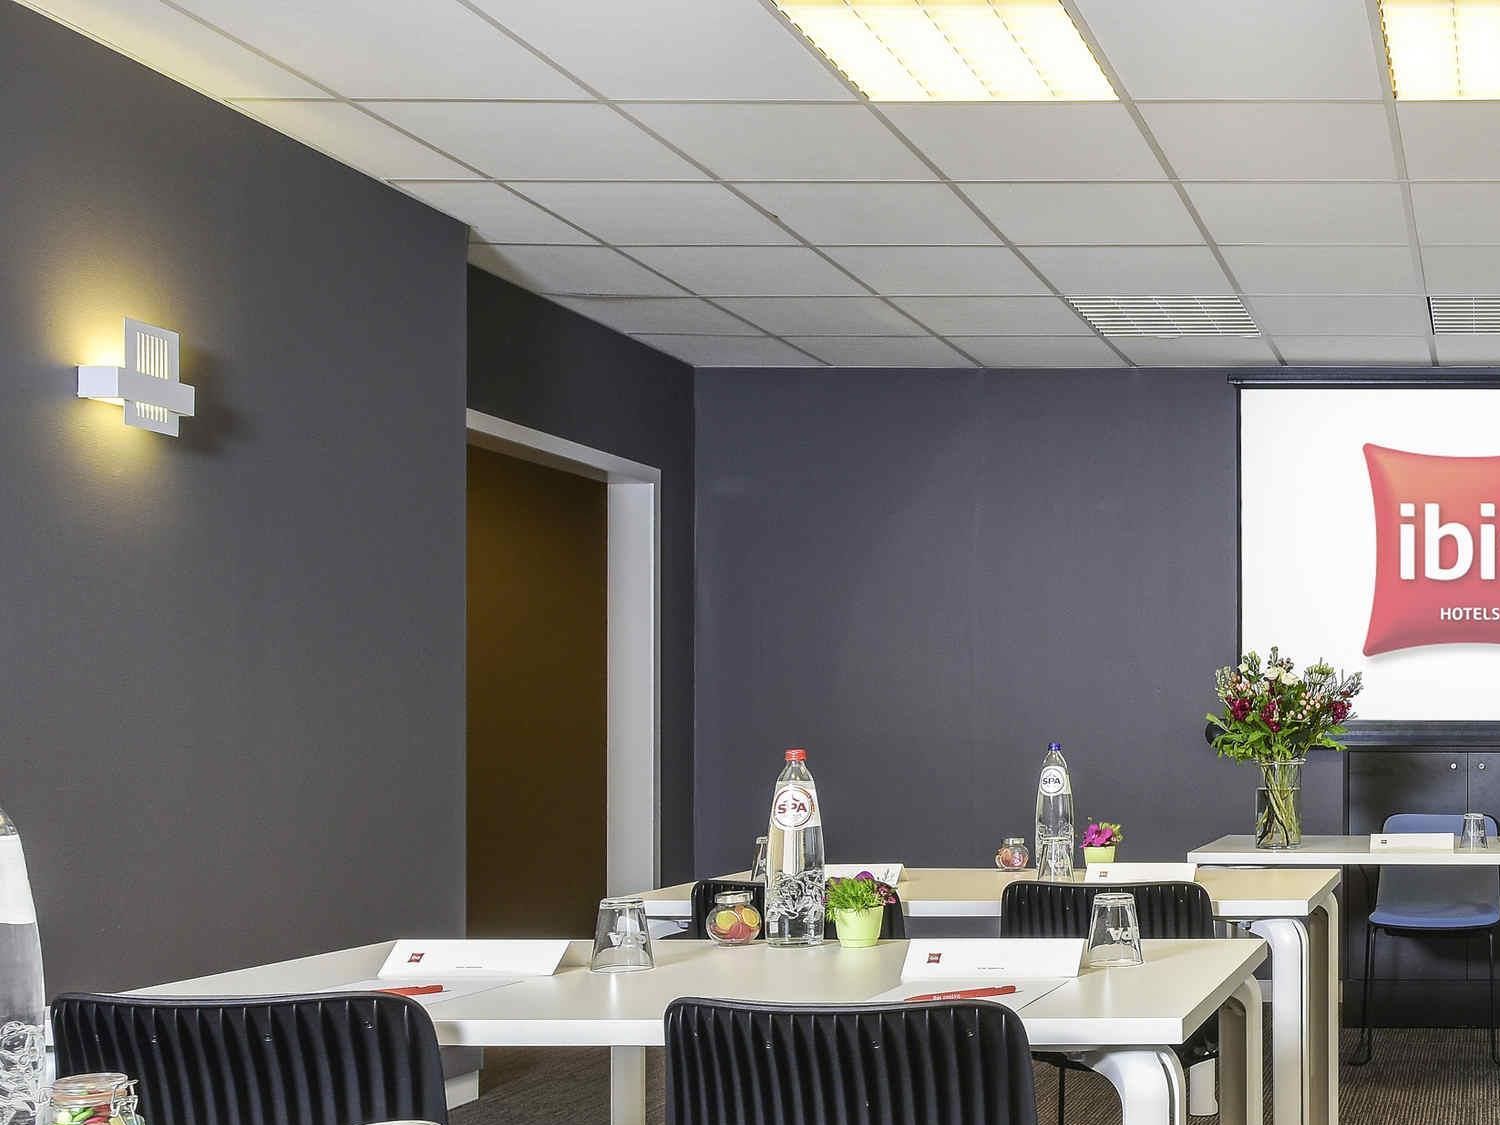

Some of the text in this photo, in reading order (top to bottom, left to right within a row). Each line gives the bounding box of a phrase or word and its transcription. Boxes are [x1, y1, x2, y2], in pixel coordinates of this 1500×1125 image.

[1439, 607, 1500, 621] HOTELS
[1041, 777, 1061, 785] SPA
[777, 802, 808, 814] SPA
